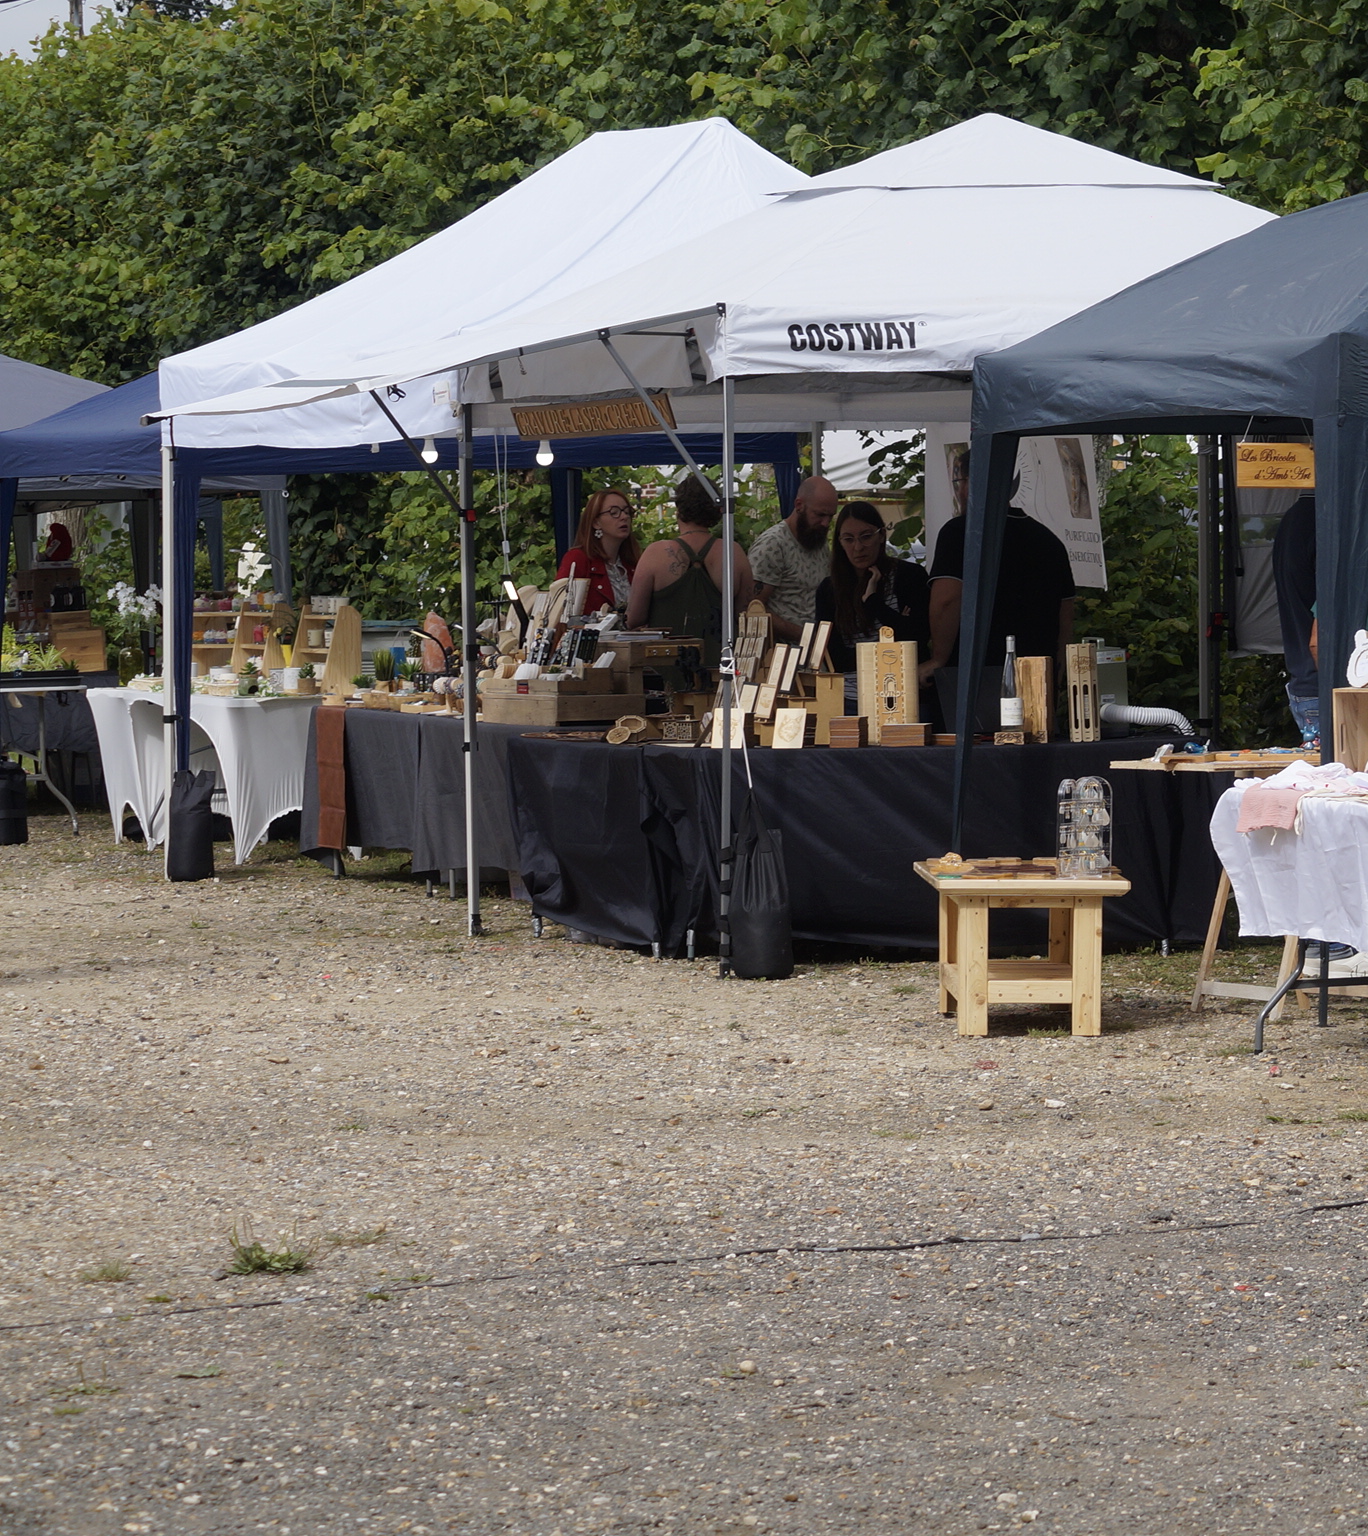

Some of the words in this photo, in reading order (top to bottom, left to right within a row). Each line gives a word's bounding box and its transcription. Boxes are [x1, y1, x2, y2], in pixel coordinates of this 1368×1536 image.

[788, 322, 916, 351] COSTWAY
[515, 408, 569, 435] GRAVURE
[1239, 448, 1257, 462] Les
[1260, 448, 1296, 462] Bricoles
[1065, 529, 1100, 543] PURIFICATIO
